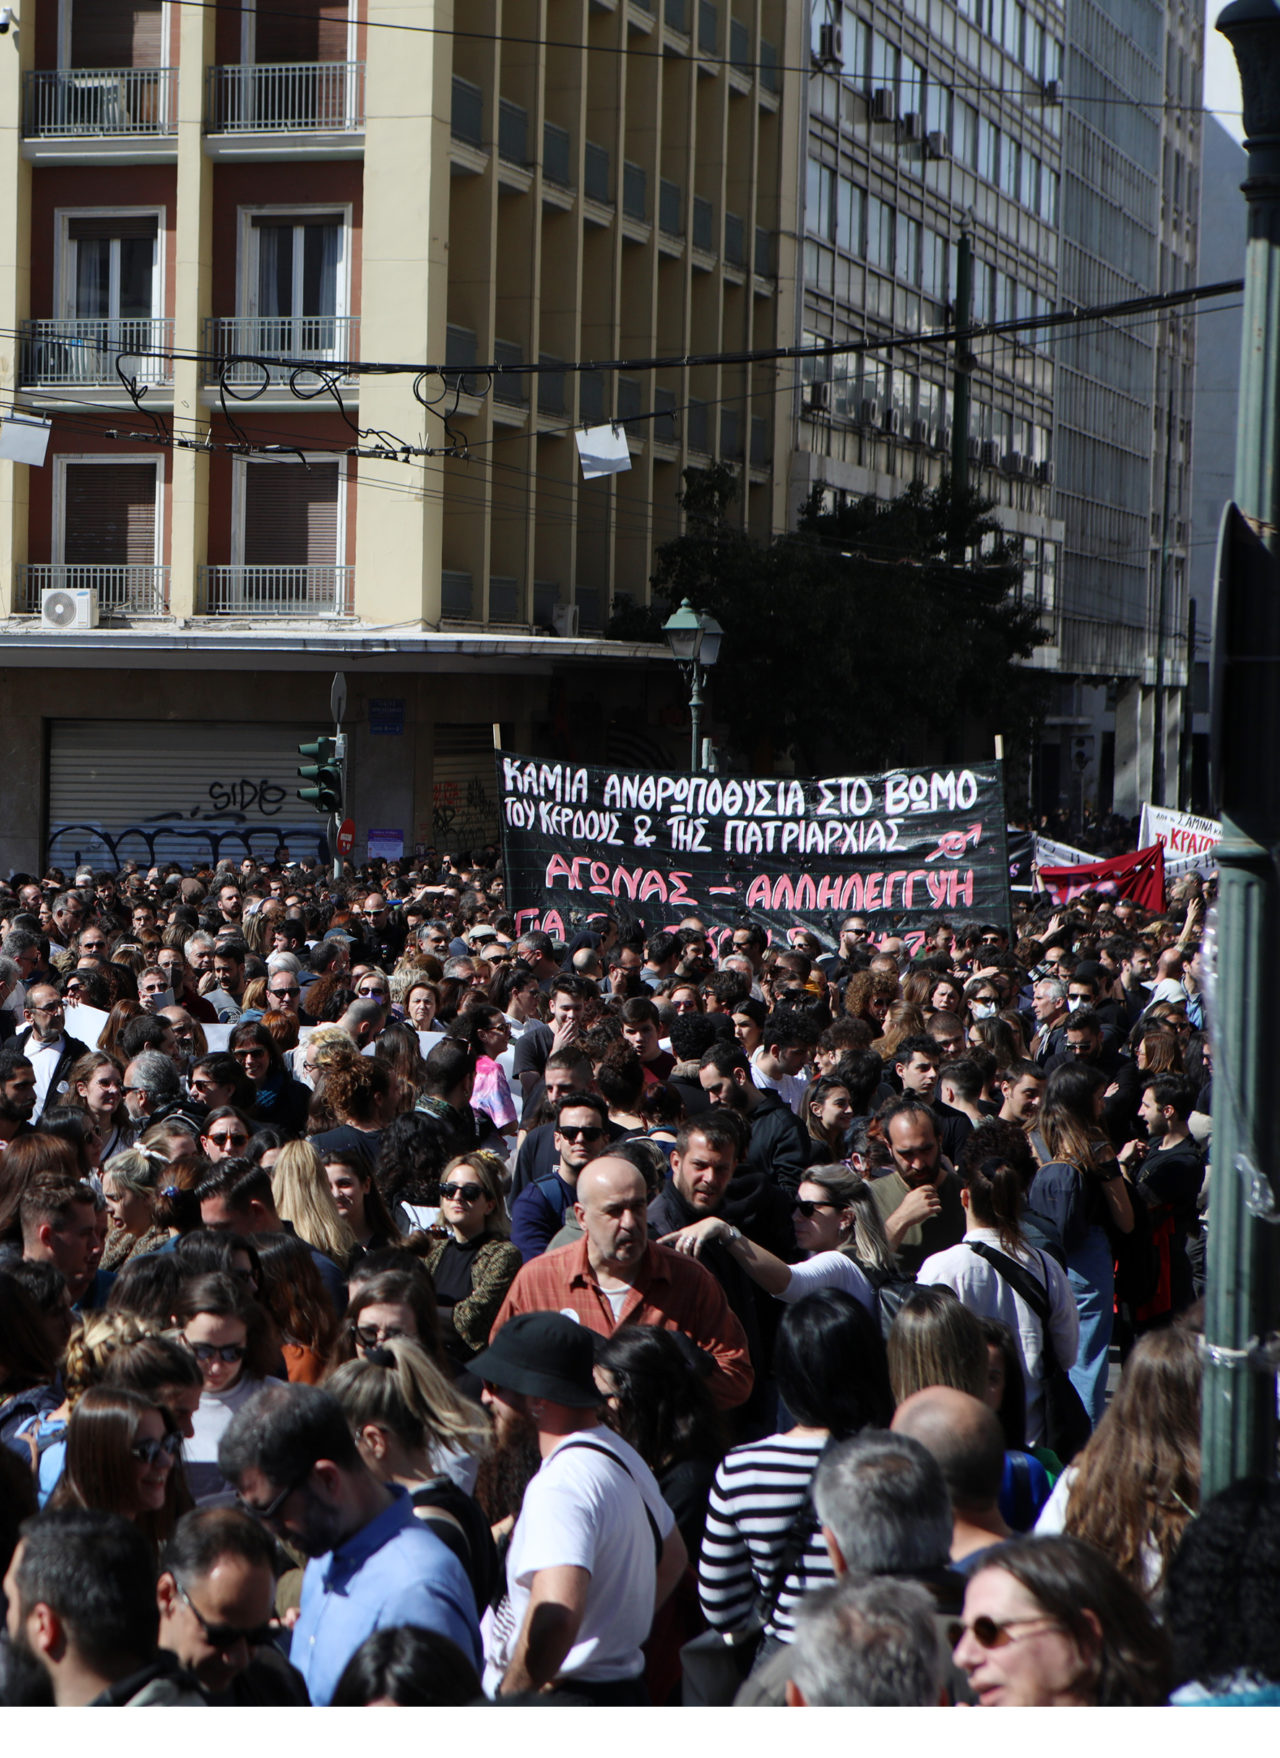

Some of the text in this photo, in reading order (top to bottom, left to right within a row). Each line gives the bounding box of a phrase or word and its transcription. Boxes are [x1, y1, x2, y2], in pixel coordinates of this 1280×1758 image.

[503, 757, 588, 803] ΚΑΜΙΑ
[603, 773, 806, 817] ΑΝΘΡΩΠΟΘΥΣΙΑ
[816, 777, 874, 817] ΣΤΟ
[884, 769, 978, 816] ΒΩΜΟ
[504, 796, 536, 830] ΤΟΥ
[538, 800, 625, 846] ΚΕΡΔΟΥΣ
[633, 814, 657, 848] &
[666, 814, 713, 853] ΤΗΣ
[723, 818, 909, 855] ΠΑΤΡΙΑΡΧΙΑΣ
[1170, 827, 1219, 855] ΚΡΑΤΟ
[544, 853, 700, 907] ΑΓΩΝΑΣ
[745, 868, 975, 914] ΑΛΛΗΛΕΓΓΥΗ
